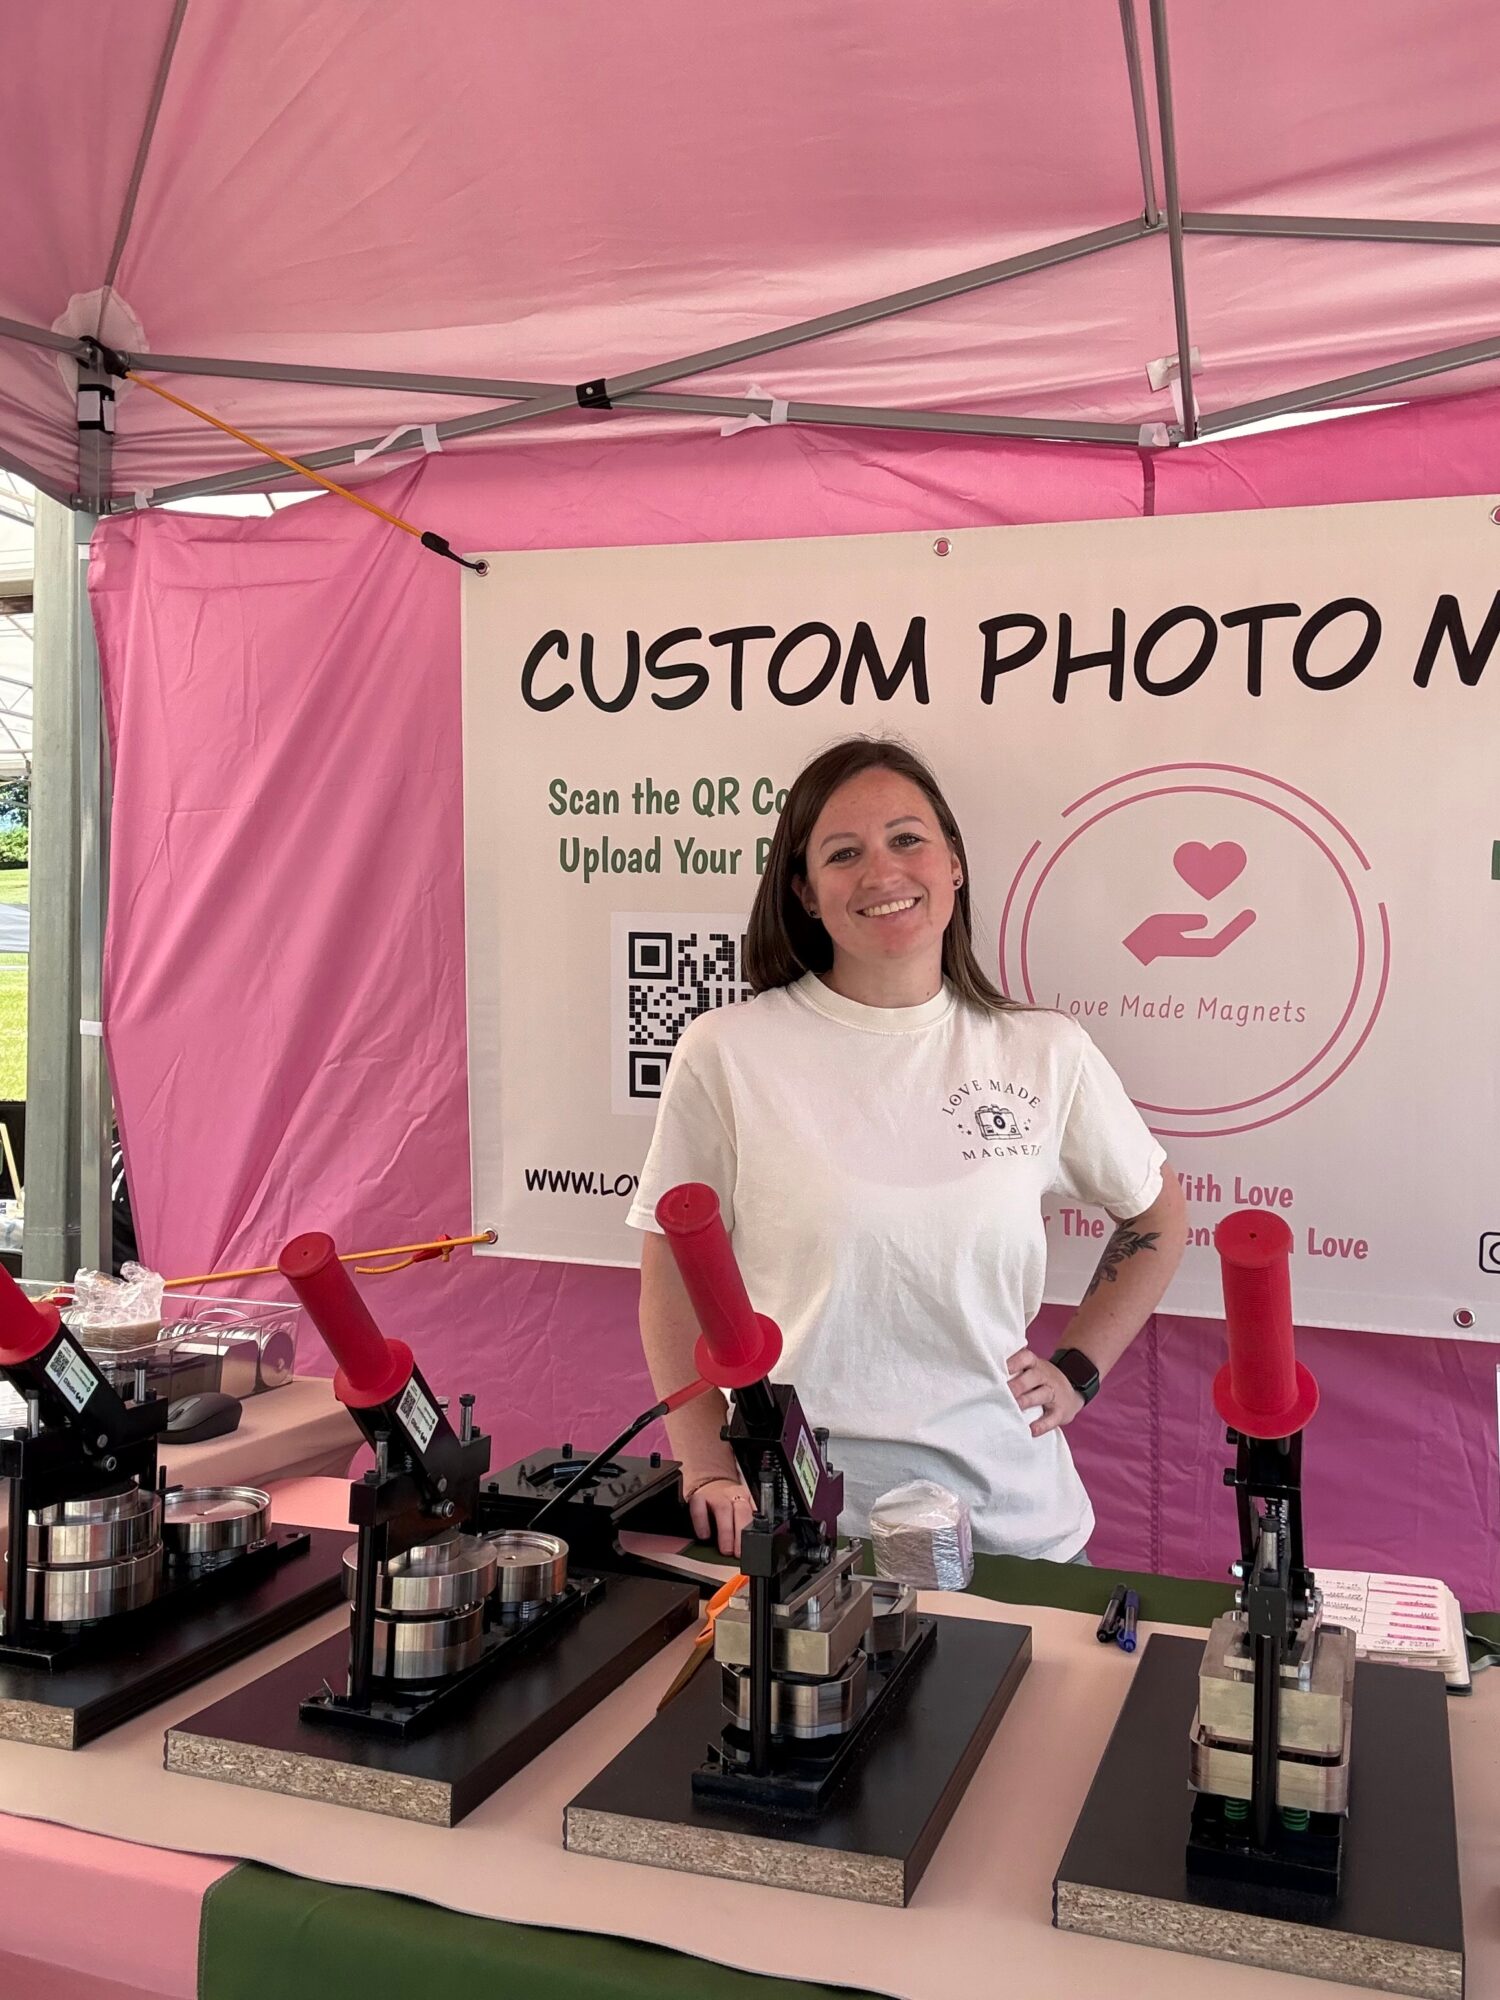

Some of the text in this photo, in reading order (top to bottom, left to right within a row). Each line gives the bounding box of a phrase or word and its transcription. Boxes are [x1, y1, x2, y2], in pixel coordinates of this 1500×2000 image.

[521, 617, 929, 712] CUSTOM
[979, 598, 1381, 705] PHOTO
[549, 779, 620, 815] Scan
[632, 777, 680, 815] the
[693, 777, 740, 817] QR
[559, 836, 661, 883] Upload
[674, 837, 742, 875] Your
[1121, 995, 1185, 1019] Made
[1198, 997, 1306, 1027] Magnets
[942, 1079, 1041, 1116] LOVE MADE
[1178, 1173, 1293, 1208] ith Love
[1059, 1208, 1104, 1238] The
[1308, 1228, 1368, 1259] Love
